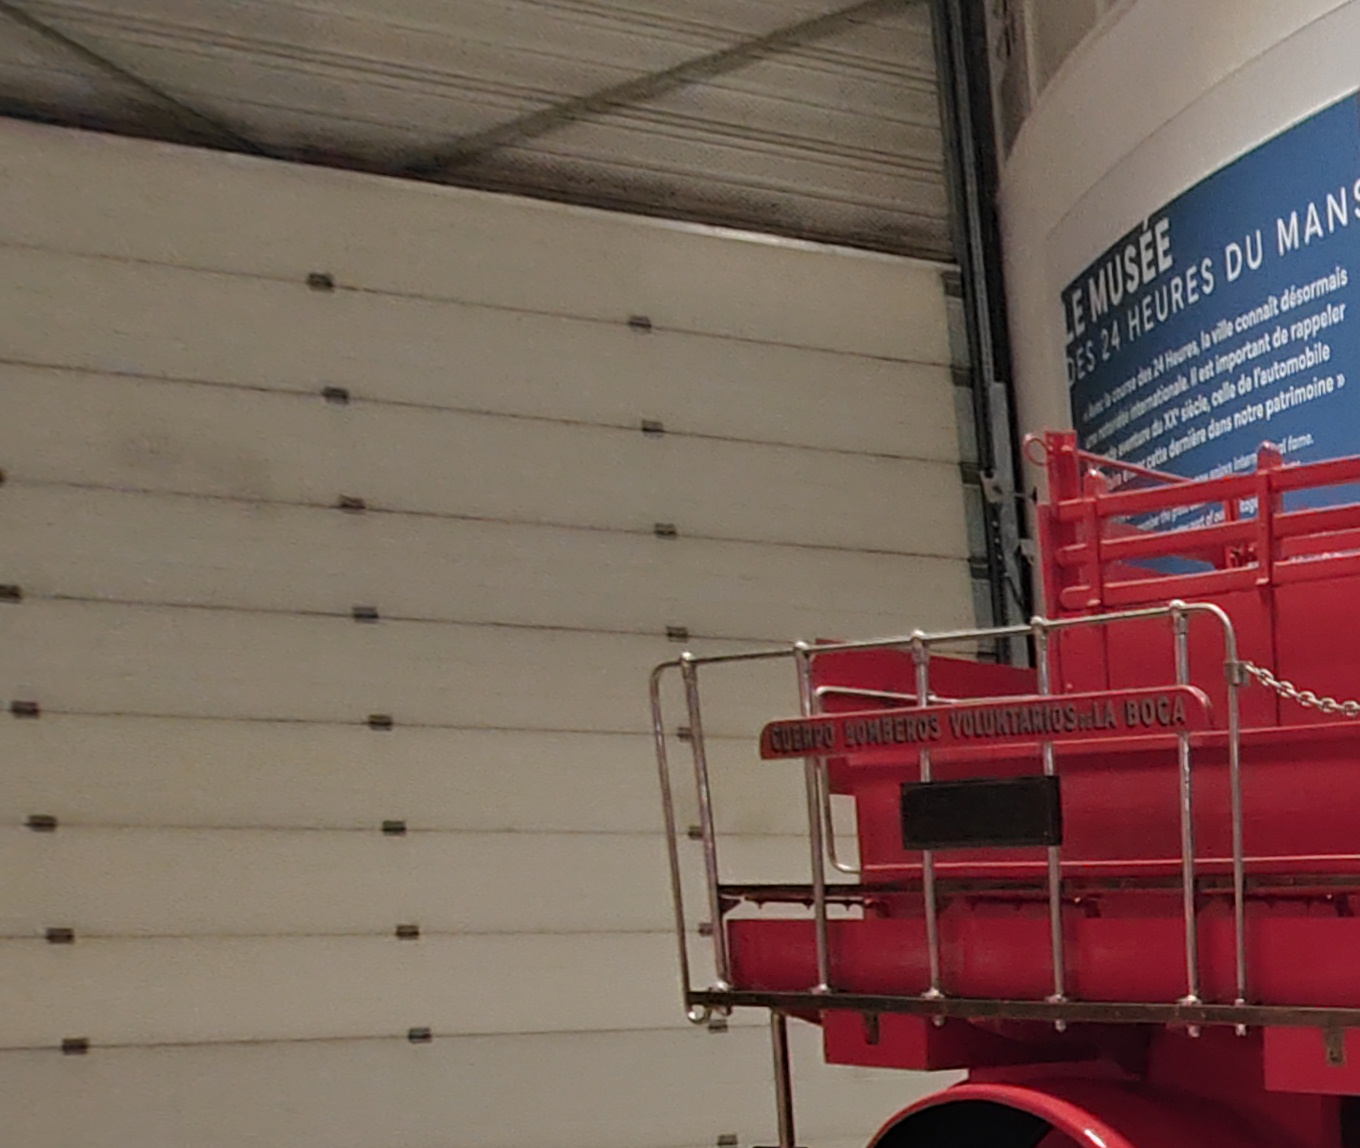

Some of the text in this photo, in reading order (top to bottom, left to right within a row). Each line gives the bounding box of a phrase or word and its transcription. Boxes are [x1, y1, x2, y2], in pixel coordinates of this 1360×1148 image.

[1066, 339, 1096, 388] DES
[1101, 319, 1120, 361] 24
[1127, 257, 1214, 343] HEURES
[1225, 229, 1262, 282] DU
[1088, 216, 1173, 323] MUSÉE
[1153, 354, 1164, 378] 24
[1201, 330, 1211, 349] la
[1211, 319, 1234, 345] ville
[1234, 296, 1279, 333] connaît
[1280, 266, 1348, 312] désormais
[1199, 360, 1215, 383] est
[1215, 333, 1271, 375] important
[1272, 326, 1288, 349] de
[1290, 303, 1346, 341] rappeler
[1208, 416, 1232, 440] dans
[1233, 402, 1264, 428] notre
[1265, 376, 1334, 421] patrimoine
[1211, 380, 1236, 407] celle
[1237, 373, 1252, 396] de
[1253, 342, 1331, 388] l'automobile
[770, 721, 835, 754] CUERPO
[843, 713, 941, 748] BOMBEROS
[950, 703, 1078, 739] VOLUNTARIOS
[1093, 700, 1116, 730] LA
[1124, 695, 1187, 728] BOCA
